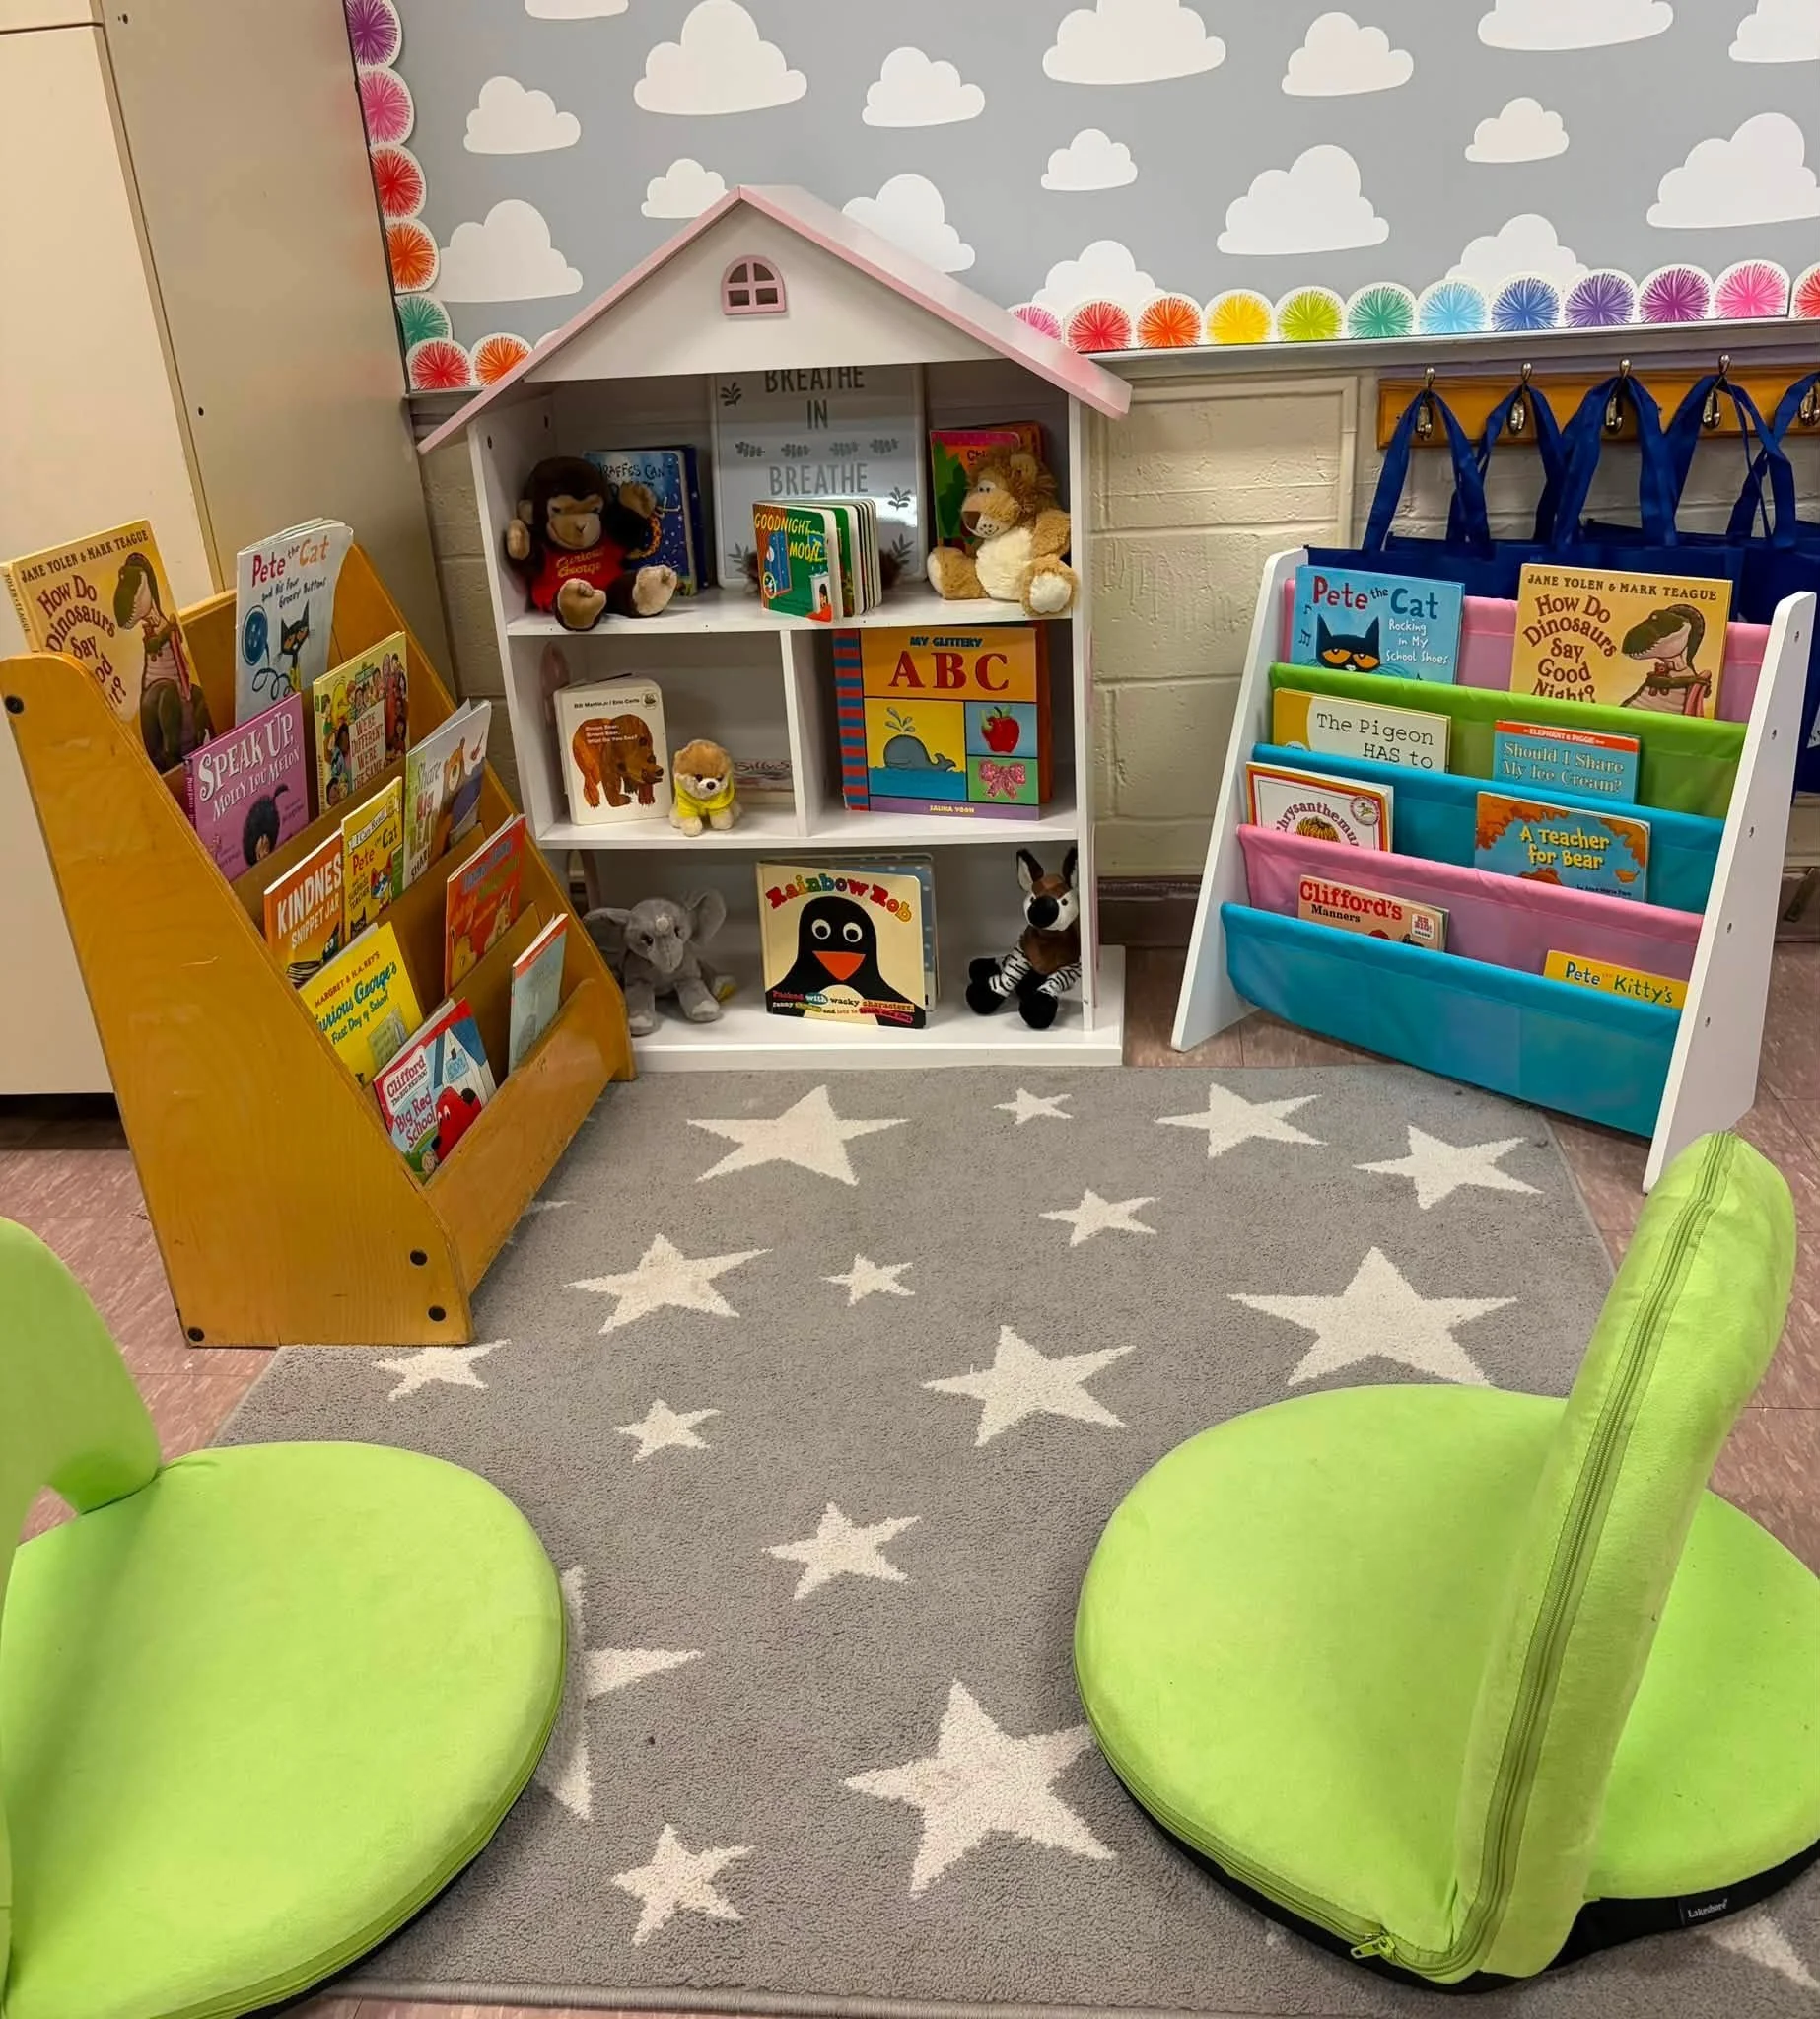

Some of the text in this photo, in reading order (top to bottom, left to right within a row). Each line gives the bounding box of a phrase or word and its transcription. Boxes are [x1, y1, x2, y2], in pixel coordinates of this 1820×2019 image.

[764, 366, 865, 393] BREATHE
[806, 399, 828, 429] IN
[769, 463, 869, 495] BREATHE
[754, 512, 811, 535] GOODNIGHT
[21, 529, 149, 584] JANE YOLEN & MARK TEAGUE
[252, 534, 330, 589] Pete the Cat
[556, 546, 605, 569] Curious
[789, 540, 822, 562] MOON
[557, 562, 602, 578] George
[36, 574, 98, 616] How Do
[1312, 575, 1439, 620] Pete the Cat
[1528, 572, 1717, 601] JANE YOLEN & MARK TEAGUE
[1534, 593, 1611, 625] How Do
[45, 603, 116, 653] Dinosaurs
[909, 636, 984, 648] MY GLITTERY
[1388, 618, 1427, 636] Rocking
[1397, 632, 1429, 650] in My
[1522, 616, 1619, 659] Dinosaurs
[71, 633, 99, 660] Say
[1385, 649, 1449, 665] School Shoes
[1550, 637, 1585, 664] Say
[95, 652, 113, 683] od
[1537, 657, 1593, 684] Good
[1316, 712, 1435, 746] The Pigeon
[1529, 728, 1566, 740] ELEPHANT
[198, 731, 264, 802] SPEAK
[1362, 741, 1434, 770] HAS to
[1504, 740, 1625, 776] Should I Share
[213, 778, 247, 822] MOLLY
[248, 769, 267, 794] LOU
[268, 747, 300, 785] MELON
[1502, 760, 1623, 793] My Ice Cream?
[1276, 801, 1360, 847] hrysanthemu
[1519, 825, 1611, 852] A Teacher
[352, 848, 375, 876] Pete
[383, 823, 398, 849] Cat
[1528, 844, 1604, 870] for Bear
[277, 852, 342, 940] KINDNES
[765, 873, 913, 923] Rainbow Rob
[1299, 880, 1404, 922] Clifford's
[291, 903, 325, 950] SNIPPET
[1310, 903, 1362, 924] Manners
[315, 978, 345, 1009] MARGRET
[315, 962, 398, 1033] urious George's
[1565, 960, 1673, 1004] Pete Kitty's
[805, 994, 828, 1004] with
[829, 997, 860, 1007] wacky
[331, 989, 390, 1046] First Day of School
[385, 1054, 427, 1098] Clifford
[395, 1085, 432, 1136] Big Red
[405, 1104, 437, 1149] School
